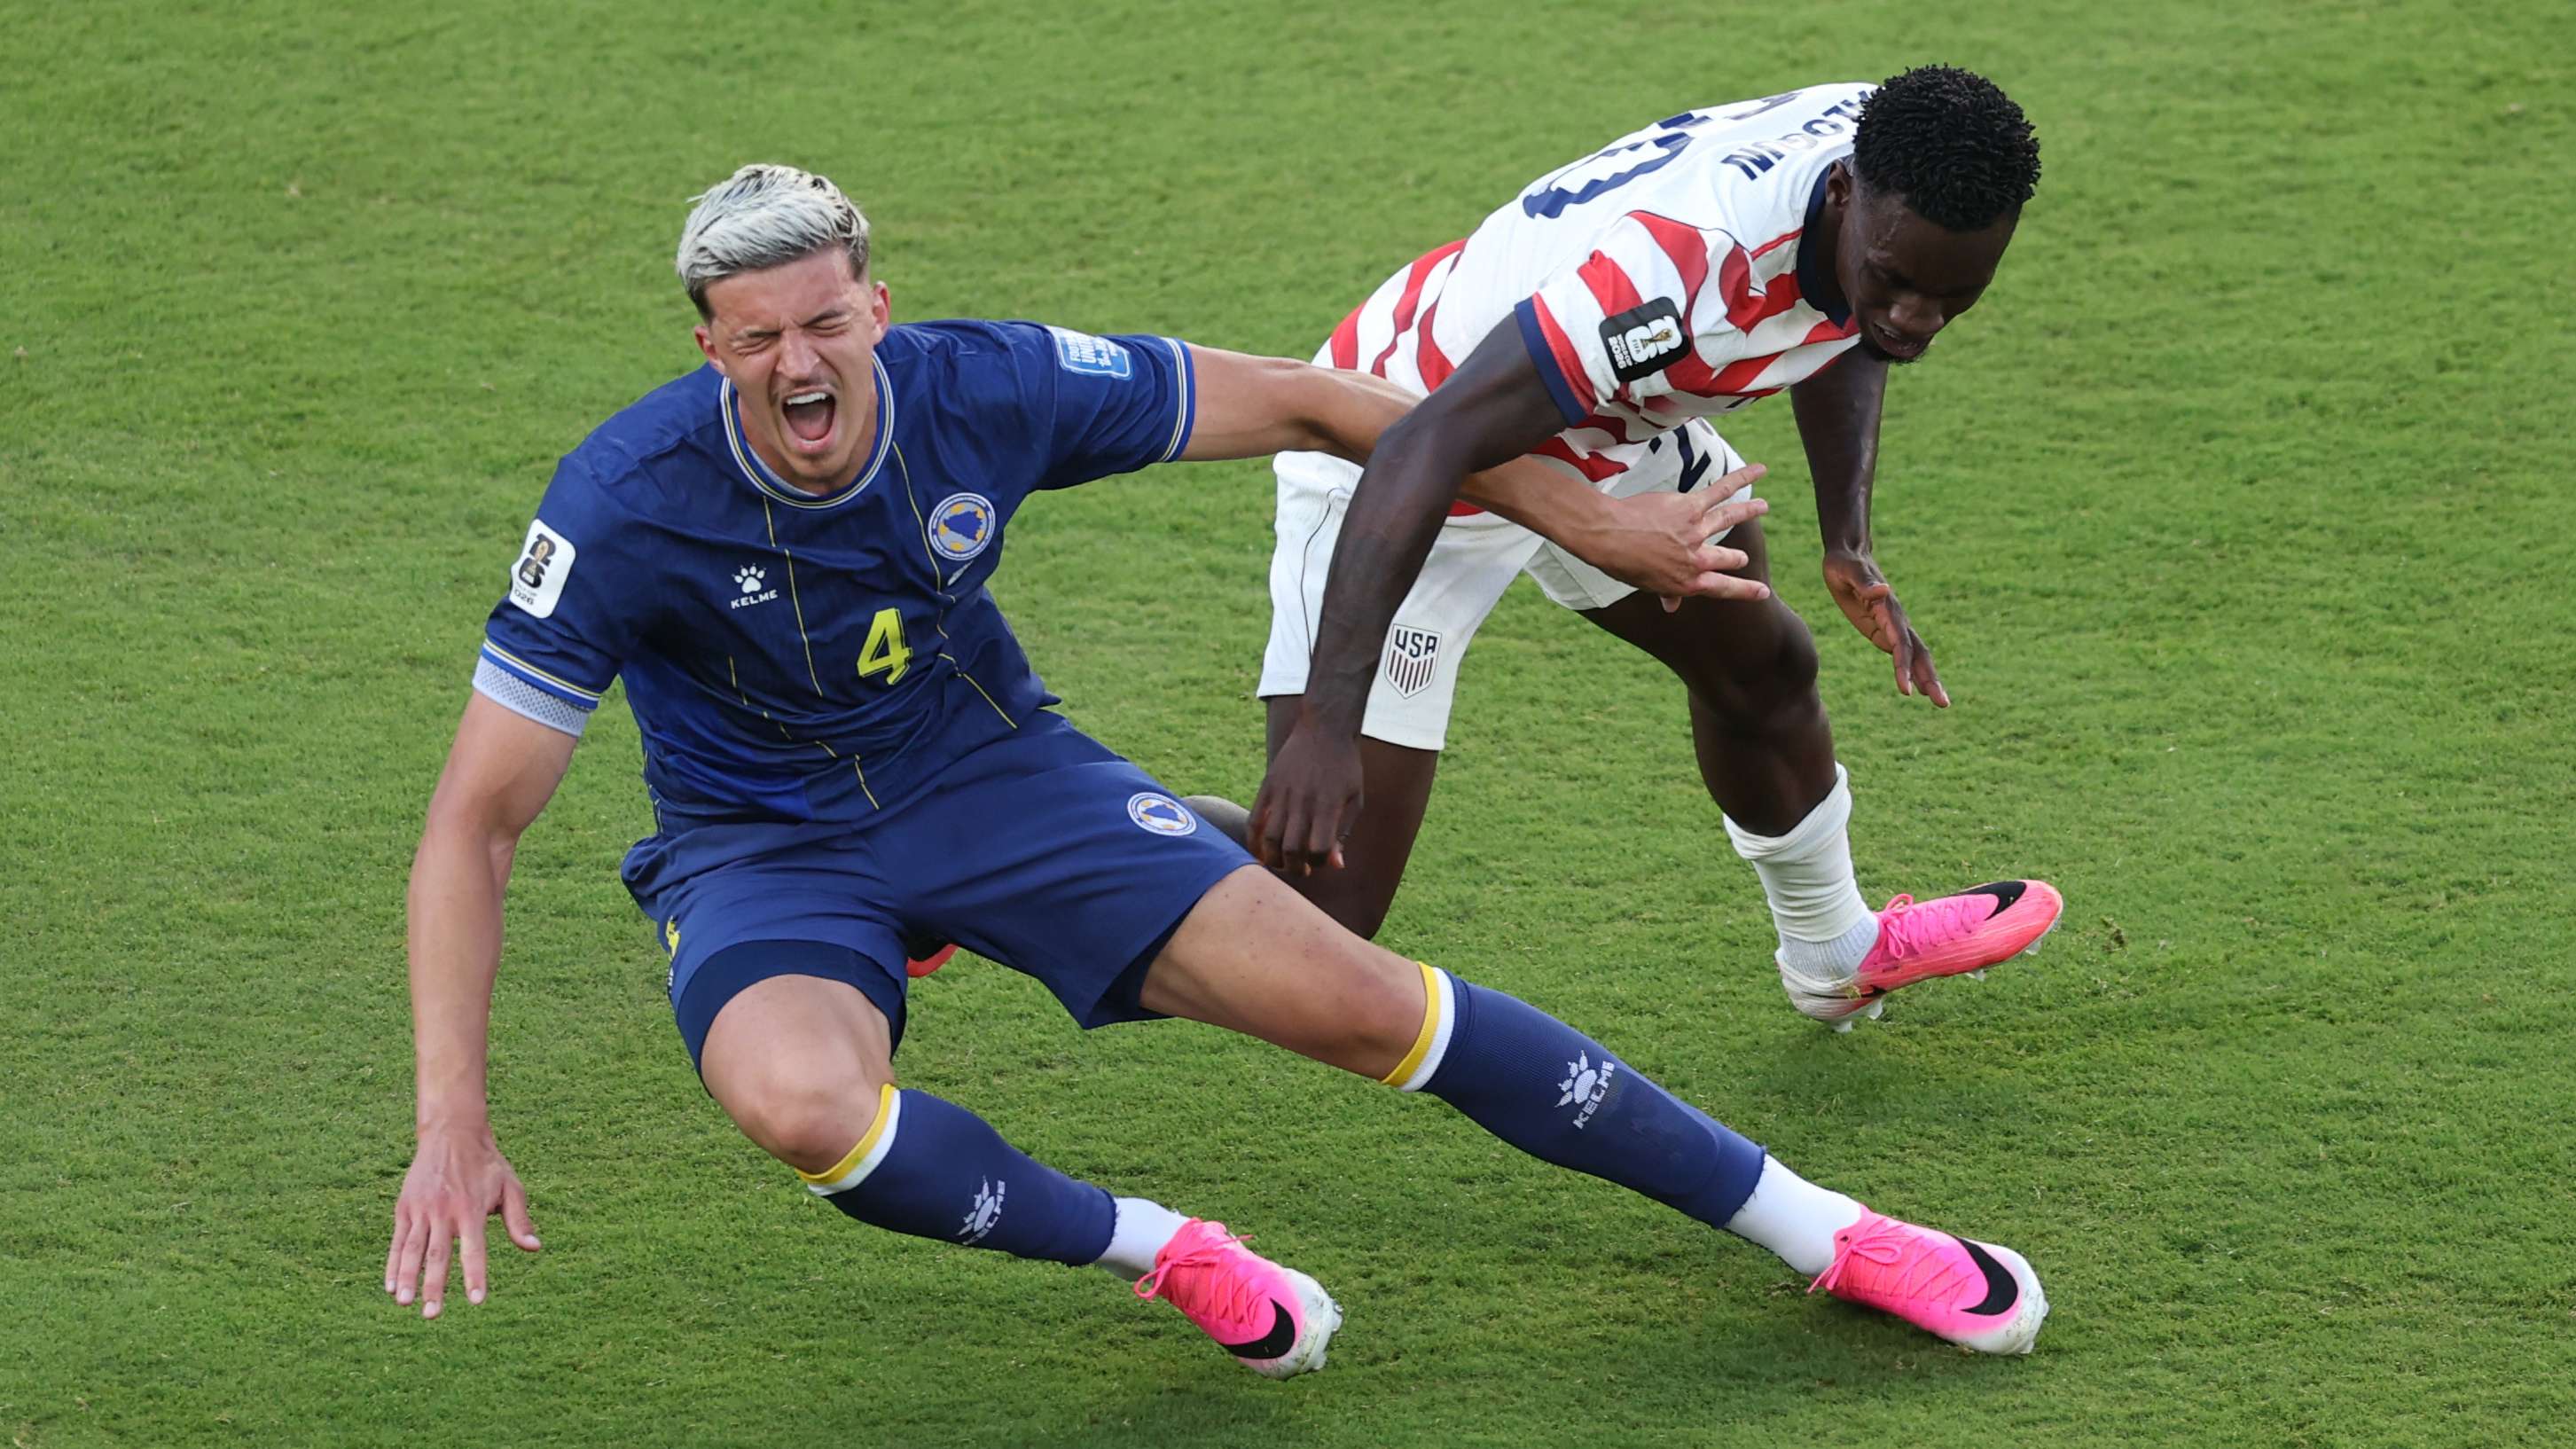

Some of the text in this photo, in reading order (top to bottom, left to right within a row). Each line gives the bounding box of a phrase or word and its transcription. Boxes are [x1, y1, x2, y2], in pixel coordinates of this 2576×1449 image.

[1607, 335, 1628, 370] 2026
[730, 589, 779, 610] KELME
[857, 607, 914, 685] 4
[1395, 629, 1438, 658] USA
